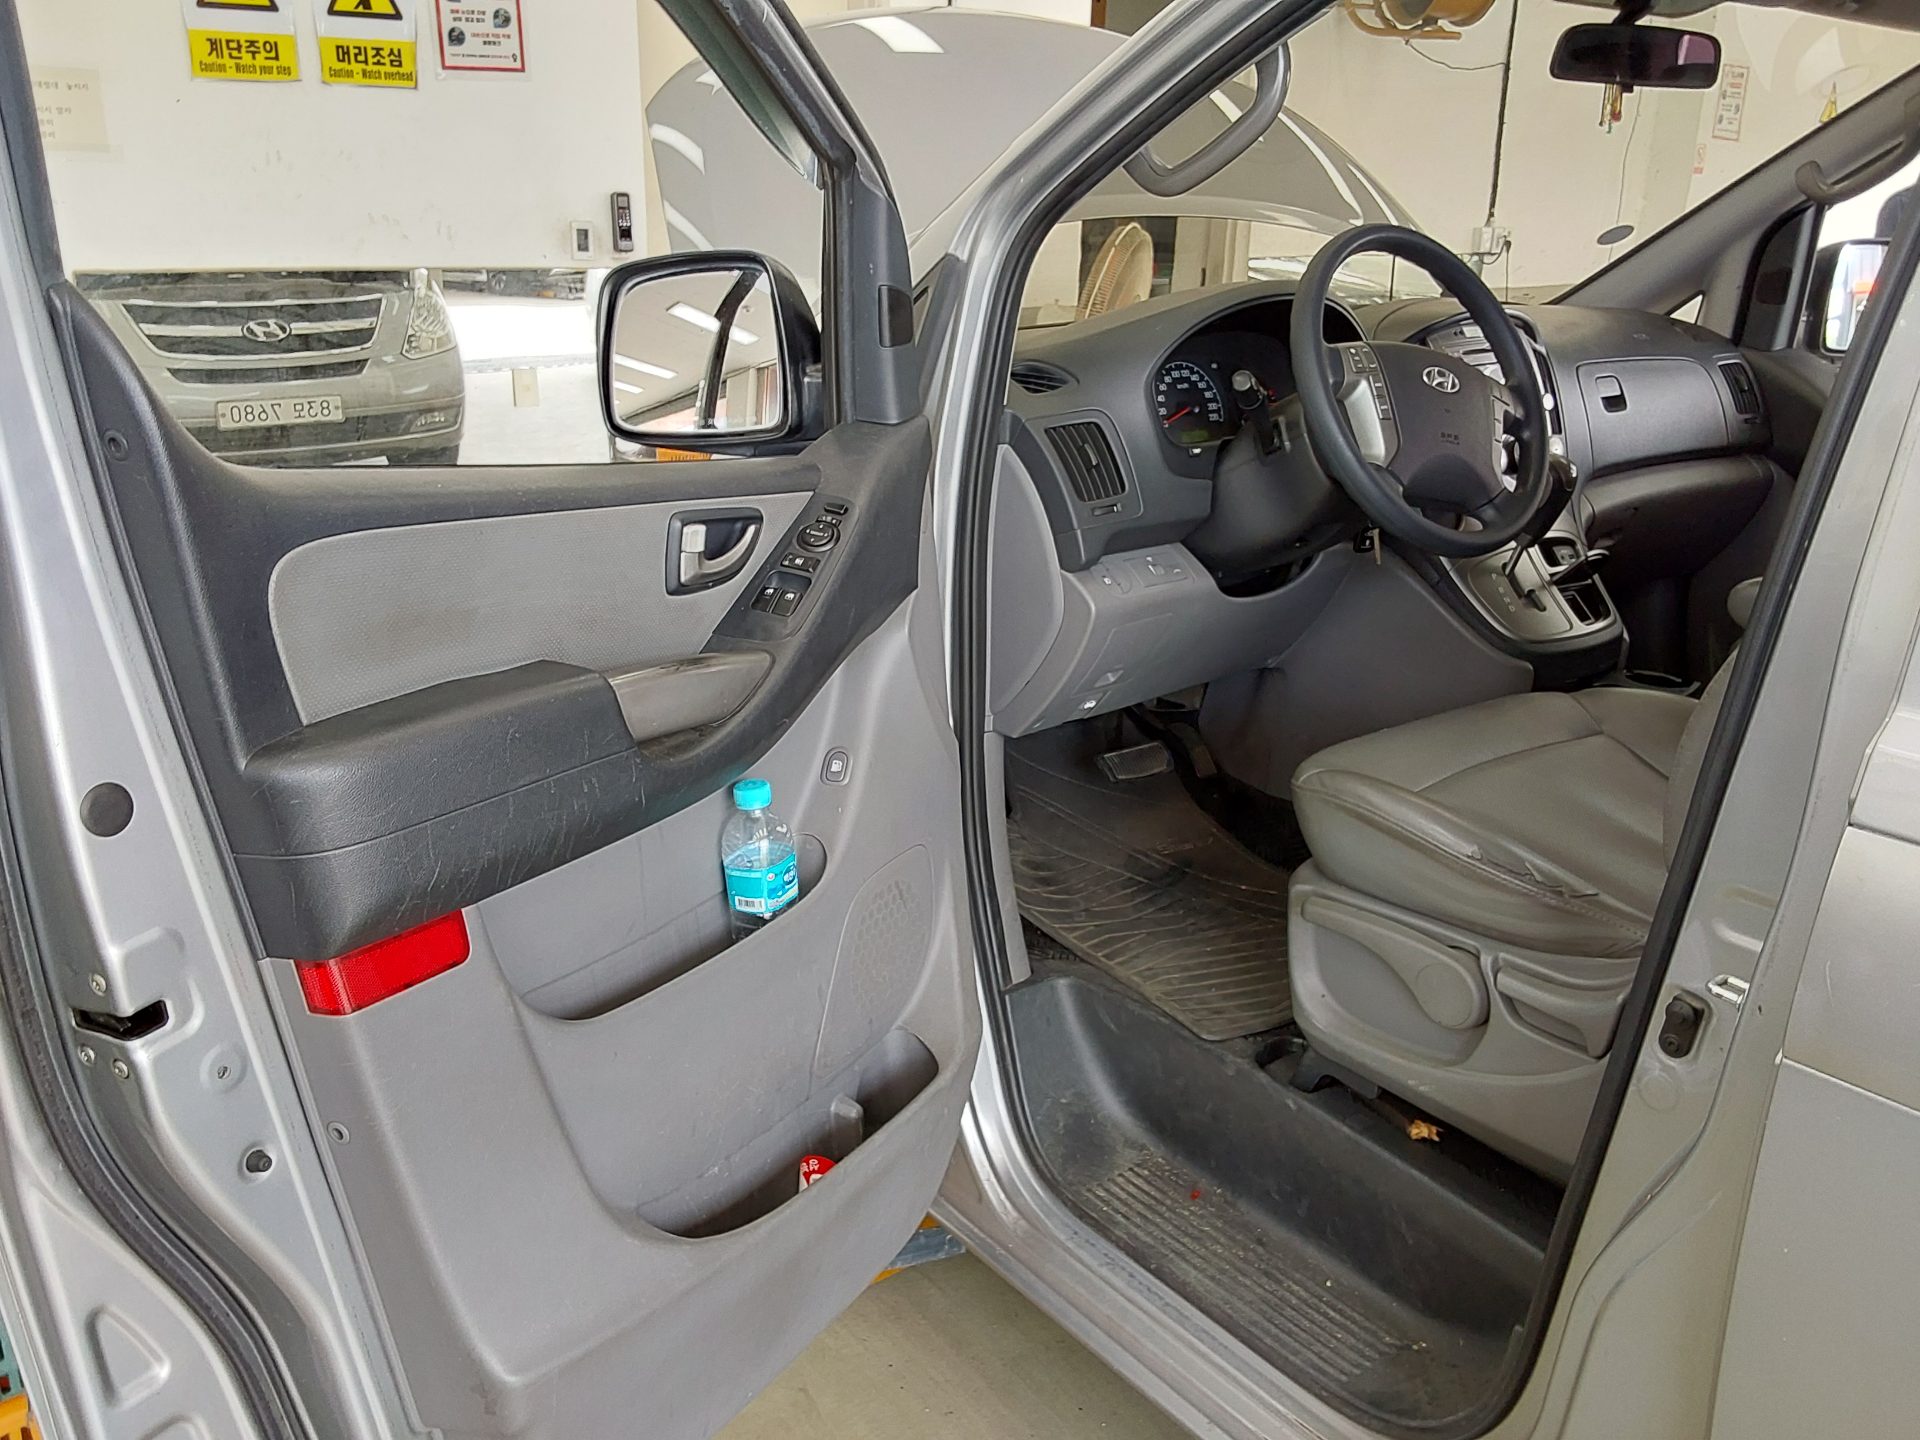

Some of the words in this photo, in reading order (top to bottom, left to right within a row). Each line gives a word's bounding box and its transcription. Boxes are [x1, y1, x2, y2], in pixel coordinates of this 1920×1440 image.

[205, 37, 280, 61] 계단주의
[335, 44, 403, 68] 머리조심
[199, 60, 227, 73] Caution
[234, 62, 257, 75] Watch
[258, 64, 274, 76] your
[276, 64, 292, 77] step
[328, 66, 354, 79] Caution
[361, 68, 383, 80] Watch
[384, 70, 414, 82] overhead
